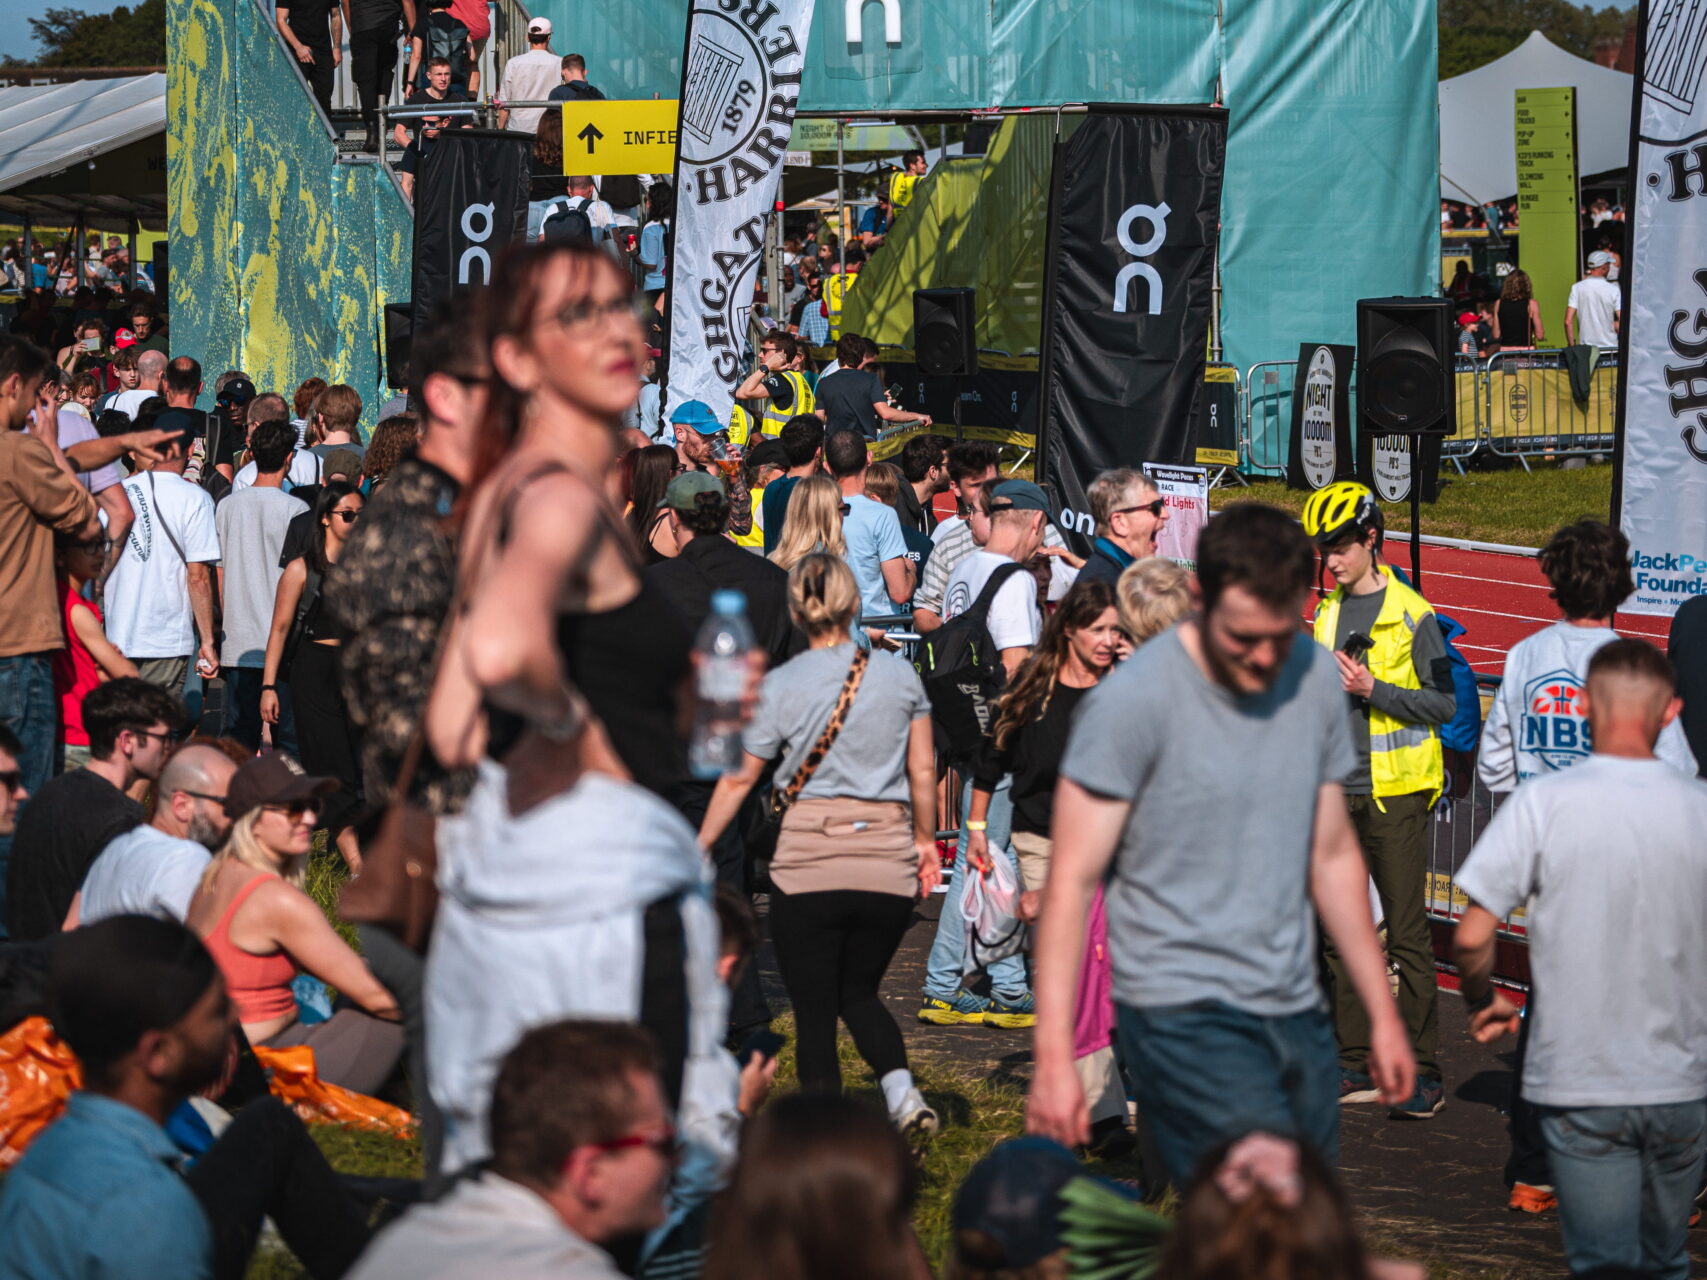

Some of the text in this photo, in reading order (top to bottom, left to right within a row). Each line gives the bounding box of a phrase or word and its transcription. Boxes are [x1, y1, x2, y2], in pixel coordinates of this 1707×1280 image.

[722, 79, 757, 136] 1879
[623, 130, 678, 145] INFIE
[1306, 383, 1332, 411] NIGHT
[1161, 483, 1174, 492] RACE
[1172, 496, 1195, 510] Lights
[1060, 507, 1096, 536] on
